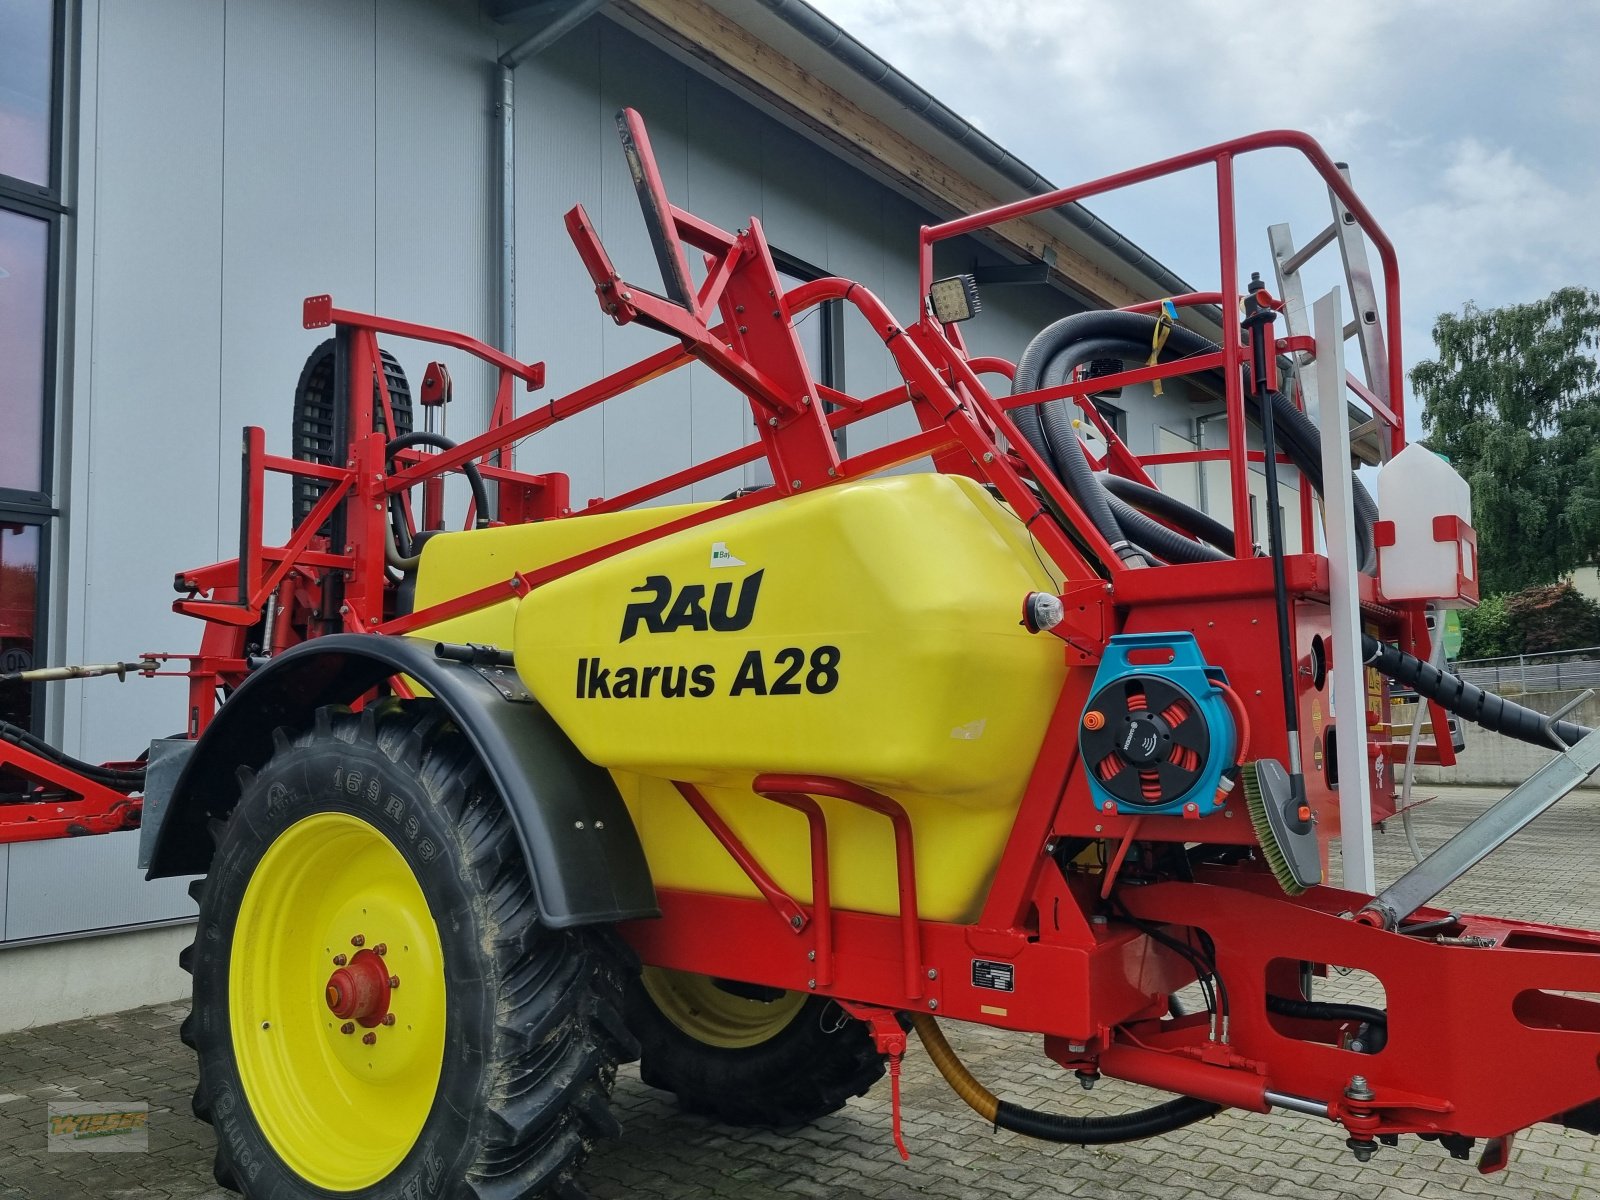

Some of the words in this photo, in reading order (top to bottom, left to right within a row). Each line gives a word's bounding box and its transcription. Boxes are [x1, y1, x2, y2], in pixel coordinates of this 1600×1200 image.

[619, 568, 765, 644] RAU
[576, 657, 716, 699] Ikarus
[729, 645, 841, 697] A28
[384, 792, 406, 825] R
[405, 814, 438, 864] 38
